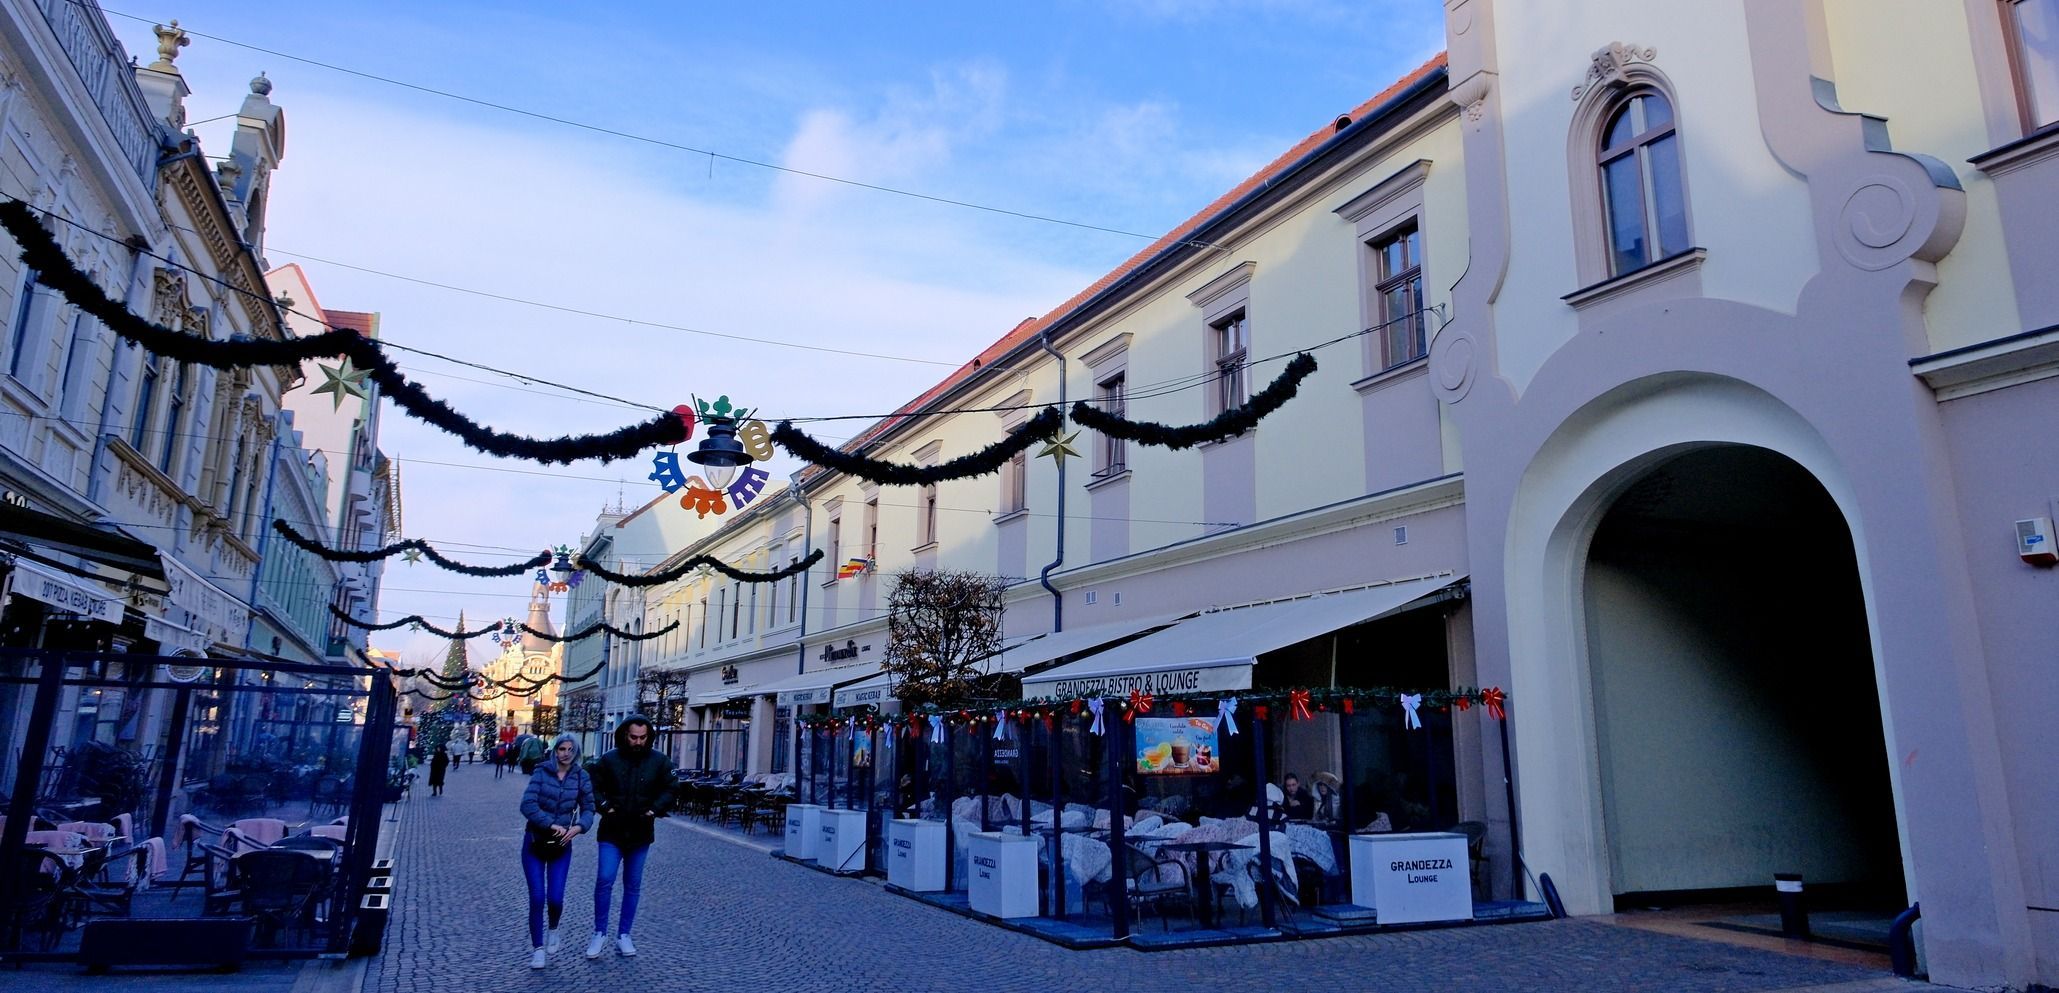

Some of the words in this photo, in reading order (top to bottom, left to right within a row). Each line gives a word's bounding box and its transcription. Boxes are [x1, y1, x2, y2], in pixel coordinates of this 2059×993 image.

[53, 584, 69, 603] PIZZA
[71, 589, 88, 610] KEBAB
[1055, 679, 1107, 697] GRANDEZZA
[1108, 675, 1142, 694] BISTRO
[1144, 674, 1152, 693] &
[1156, 671, 1199, 690] LOUNGE
[974, 855, 996, 868] GRANDEZZA
[1391, 859, 1453, 872] GRANDEZZA
